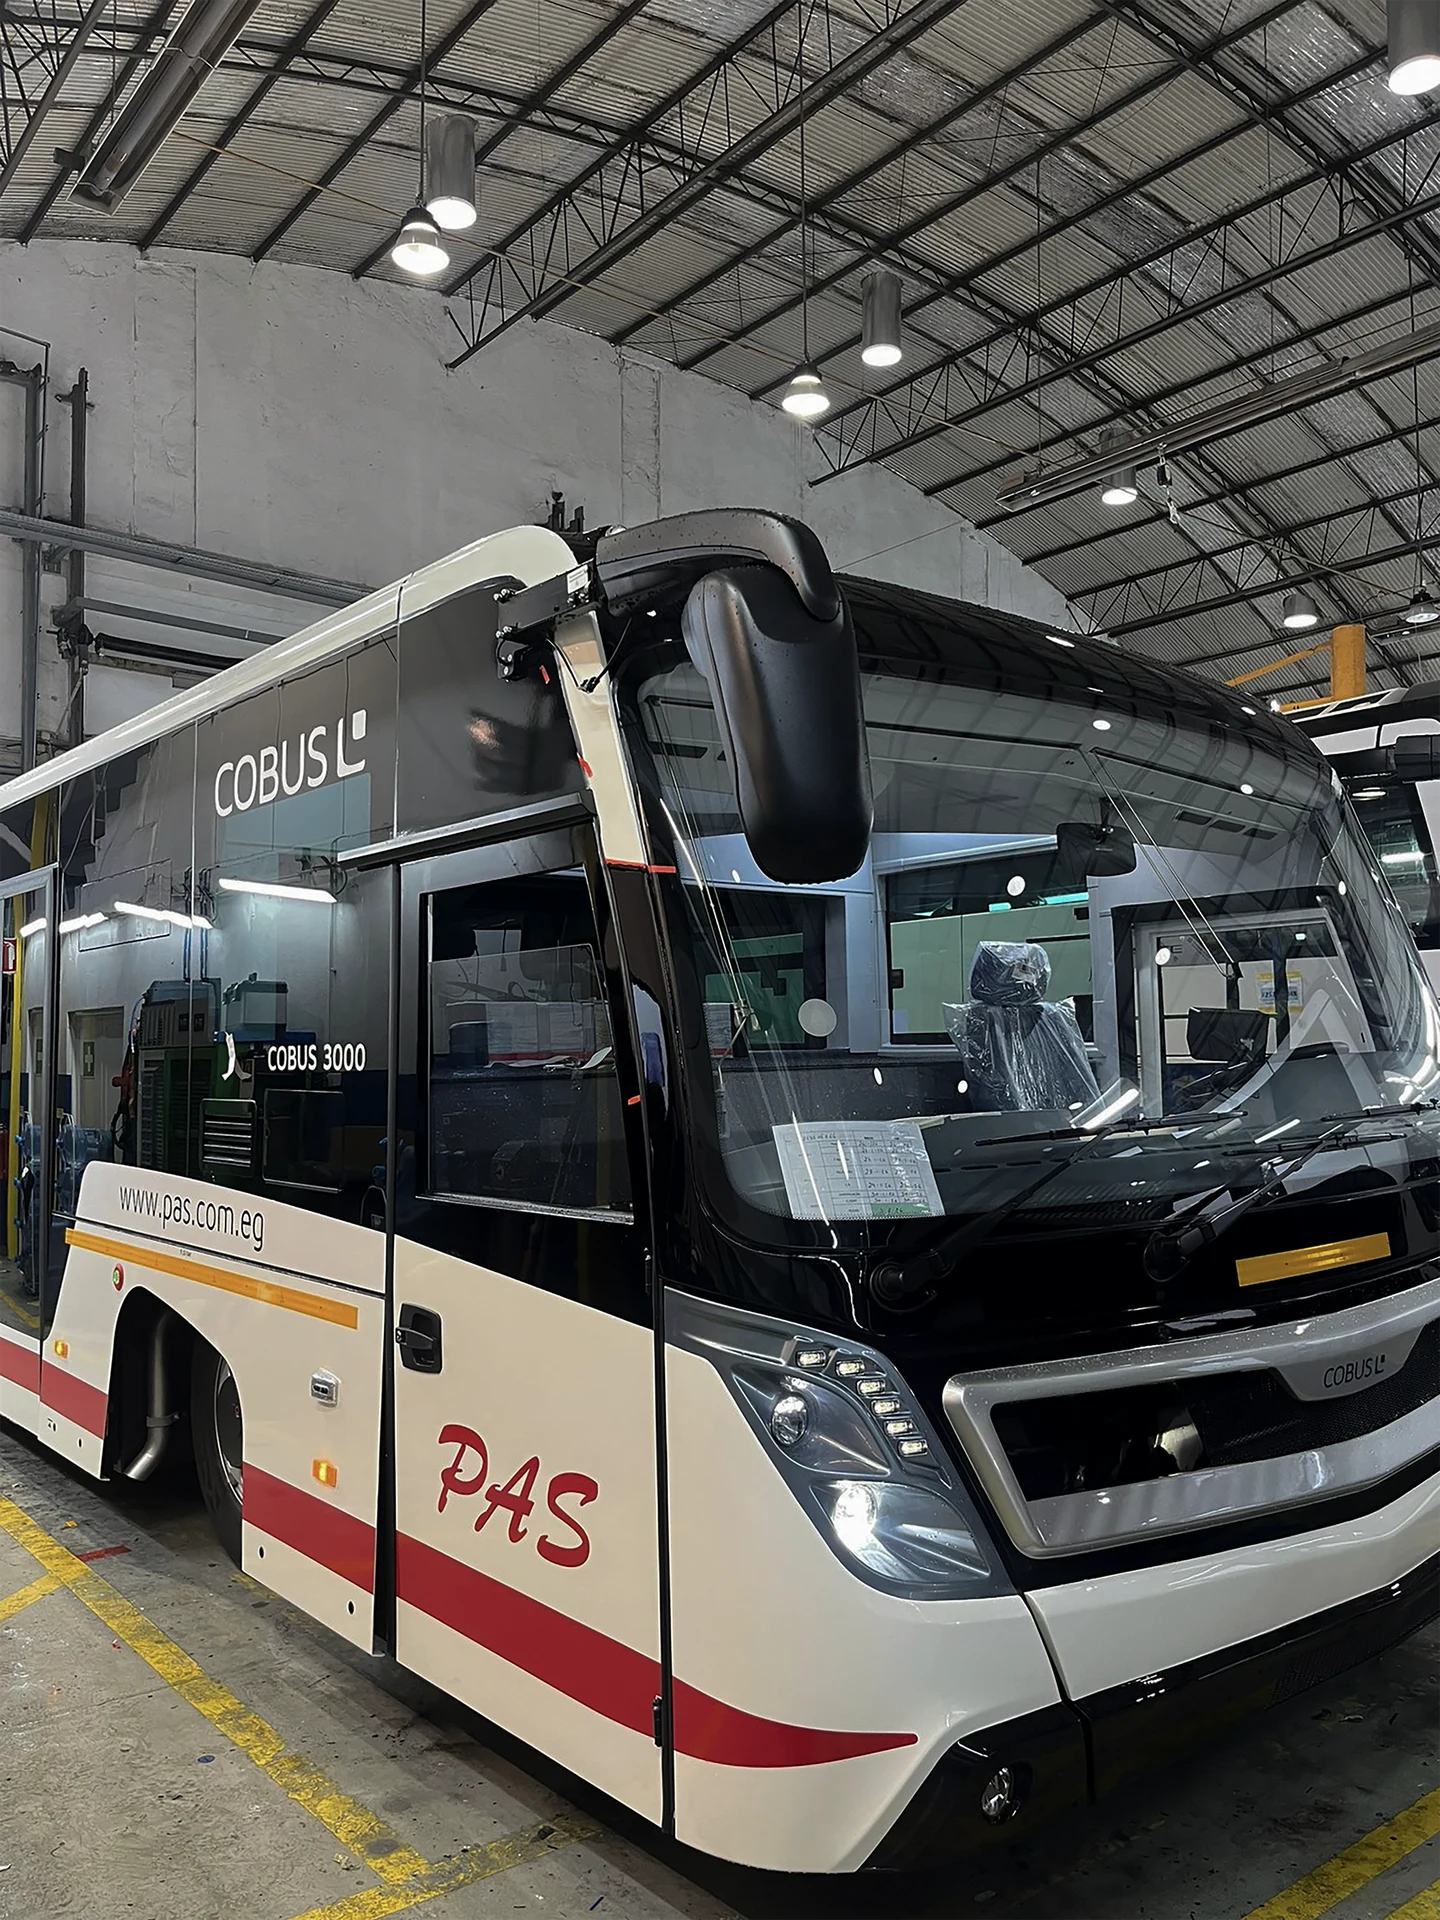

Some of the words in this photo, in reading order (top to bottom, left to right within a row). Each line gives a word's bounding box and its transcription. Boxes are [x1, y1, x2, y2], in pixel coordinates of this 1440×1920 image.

[214, 725, 328, 817] COBUS
[267, 1044, 317, 1072] COBUS
[323, 1043, 366, 1072] 3000
[119, 1186, 264, 1252] www.pas.com.eg
[1323, 1357, 1373, 1388] COBUS
[437, 1424, 599, 1568] PAS
